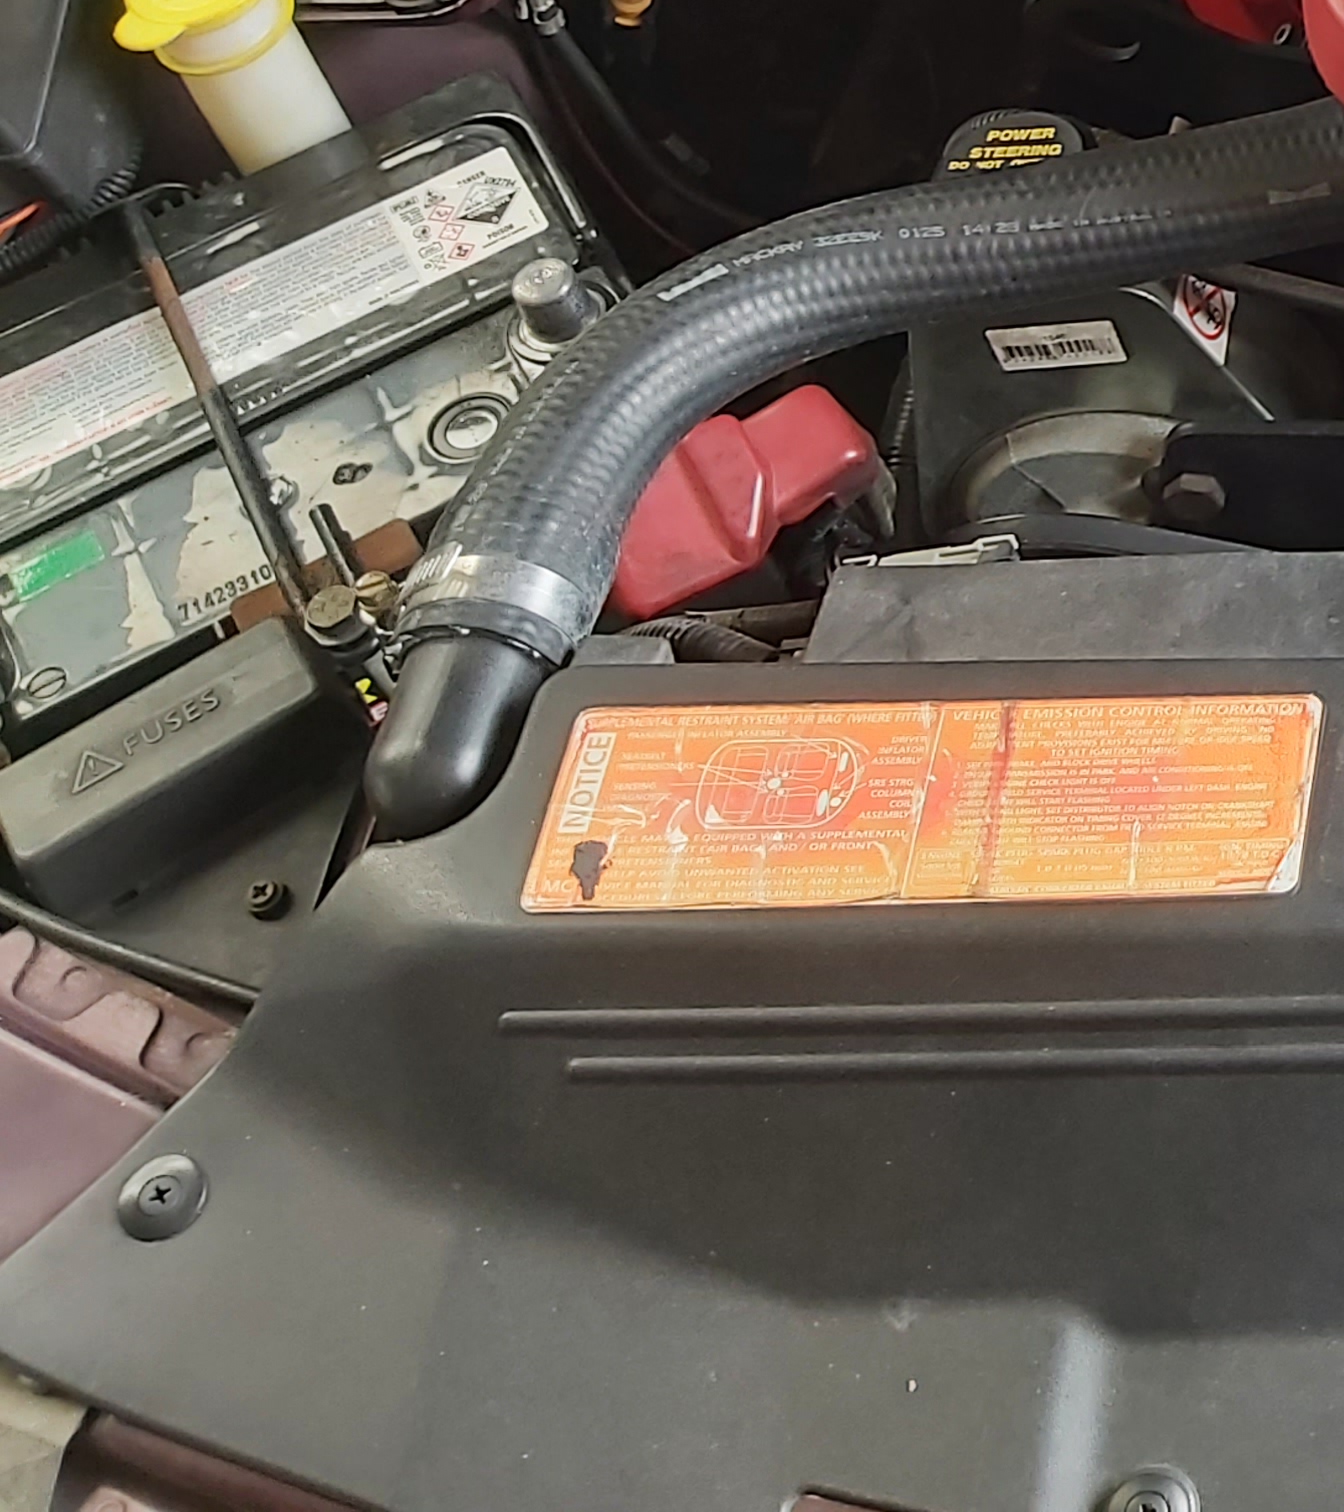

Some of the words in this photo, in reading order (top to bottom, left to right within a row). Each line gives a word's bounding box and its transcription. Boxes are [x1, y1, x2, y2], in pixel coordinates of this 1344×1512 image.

[986, 127, 1056, 142] POWER
[969, 144, 1062, 158] STEERING
[948, 161, 970, 170] DO
[732, 240, 804, 268] MACKAY
[677, 713, 740, 726] RESTRAINT
[846, 712, 892, 724] (WHERE
[953, 707, 1019, 721] VEHIC
[1023, 707, 1104, 719] EMISSION
[1109, 705, 1183, 716] CONTROL
[1189, 703, 1303, 716] INFORMATION
[123, 688, 221, 756] FUSES
[563, 734, 611, 830] NOTICE
[693, 833, 757, 843] EQUIPPED
[830, 841, 874, 851] FRONT
